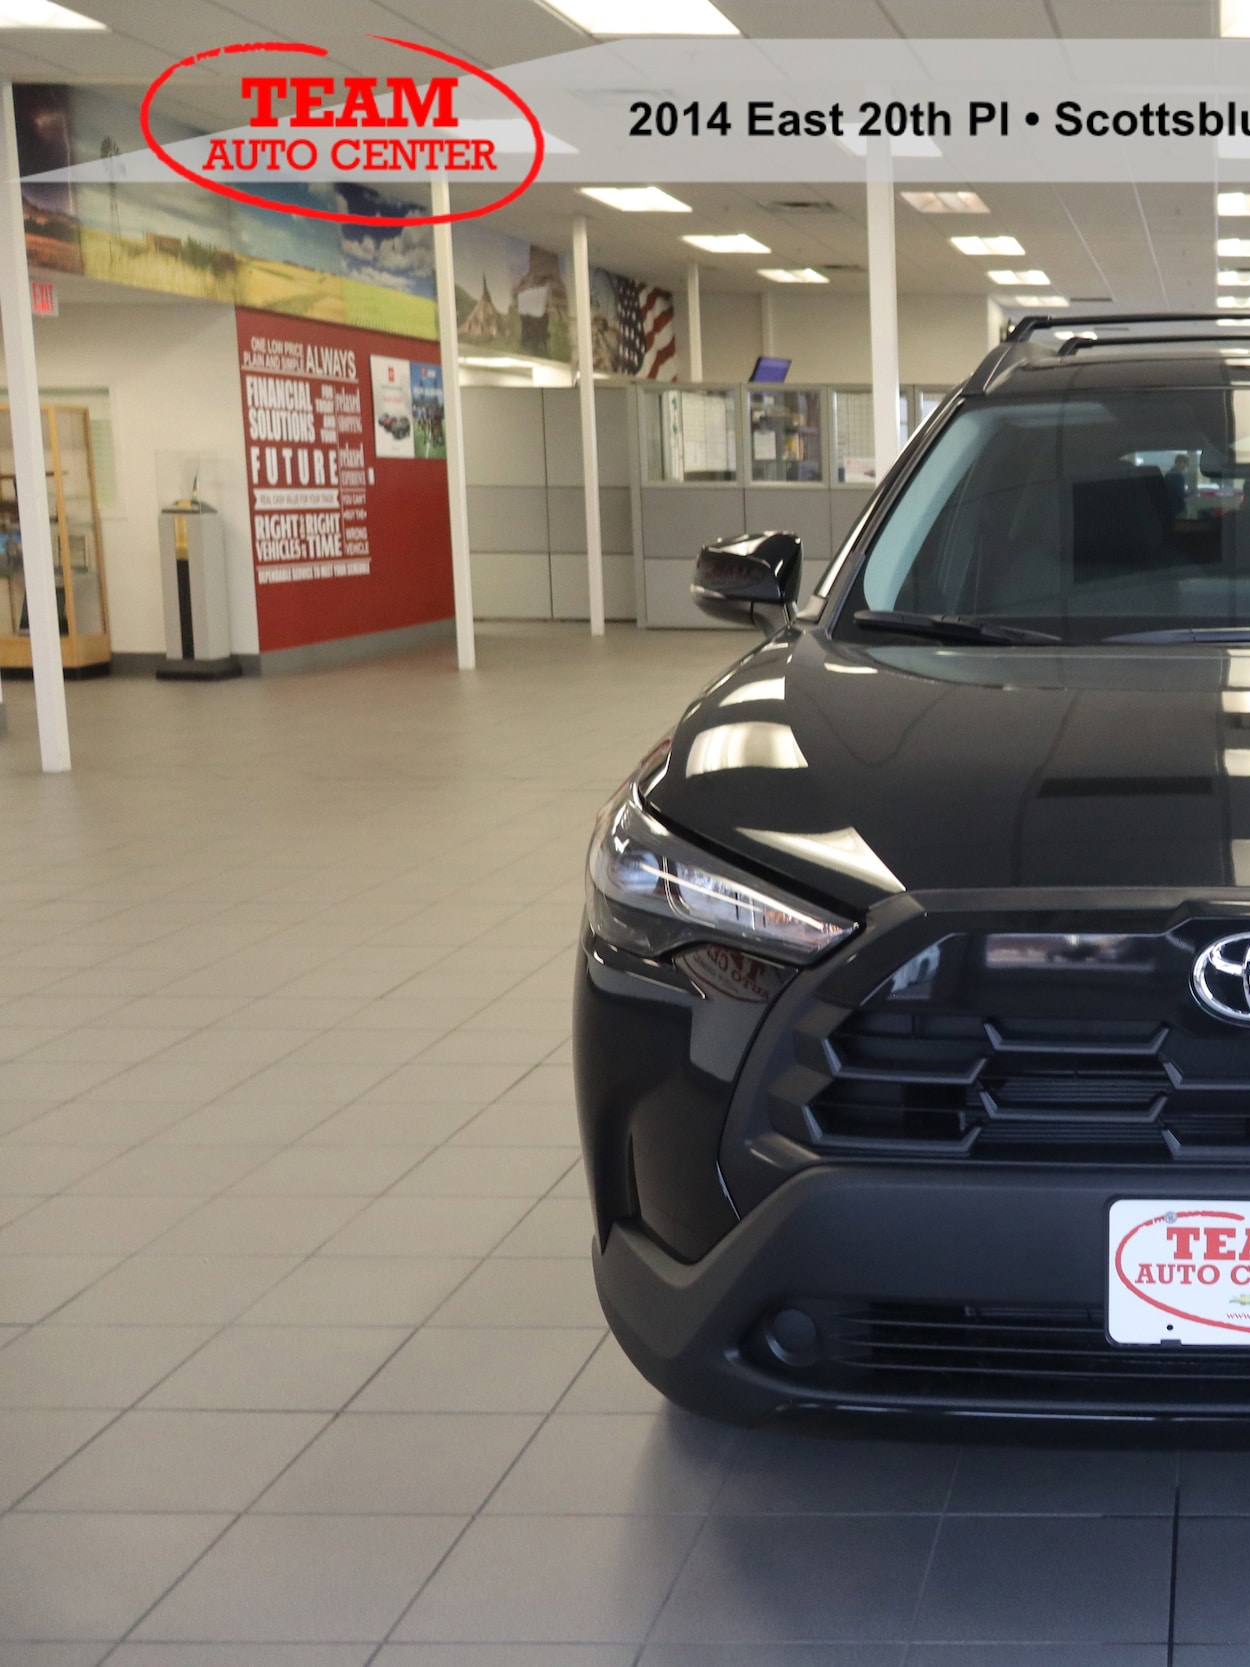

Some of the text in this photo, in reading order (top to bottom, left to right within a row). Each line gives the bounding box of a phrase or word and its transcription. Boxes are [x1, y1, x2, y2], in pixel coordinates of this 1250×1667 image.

[31, 281, 55, 313] EXIT
[243, 350, 266, 369] PLAIN
[251, 336, 304, 359] ONE LOW PRICE
[306, 343, 357, 380] ALWAYS
[246, 374, 313, 412] FINANCIAL
[248, 407, 316, 443] SOLUTIONS
[251, 446, 339, 485] FUTURE
[254, 514, 299, 541] RIGHT
[305, 512, 341, 536] RIGHT
[256, 538, 301, 562] VEHICLES
[307, 533, 342, 559] TIME
[1135, 1263, 1220, 1285] AUTO
